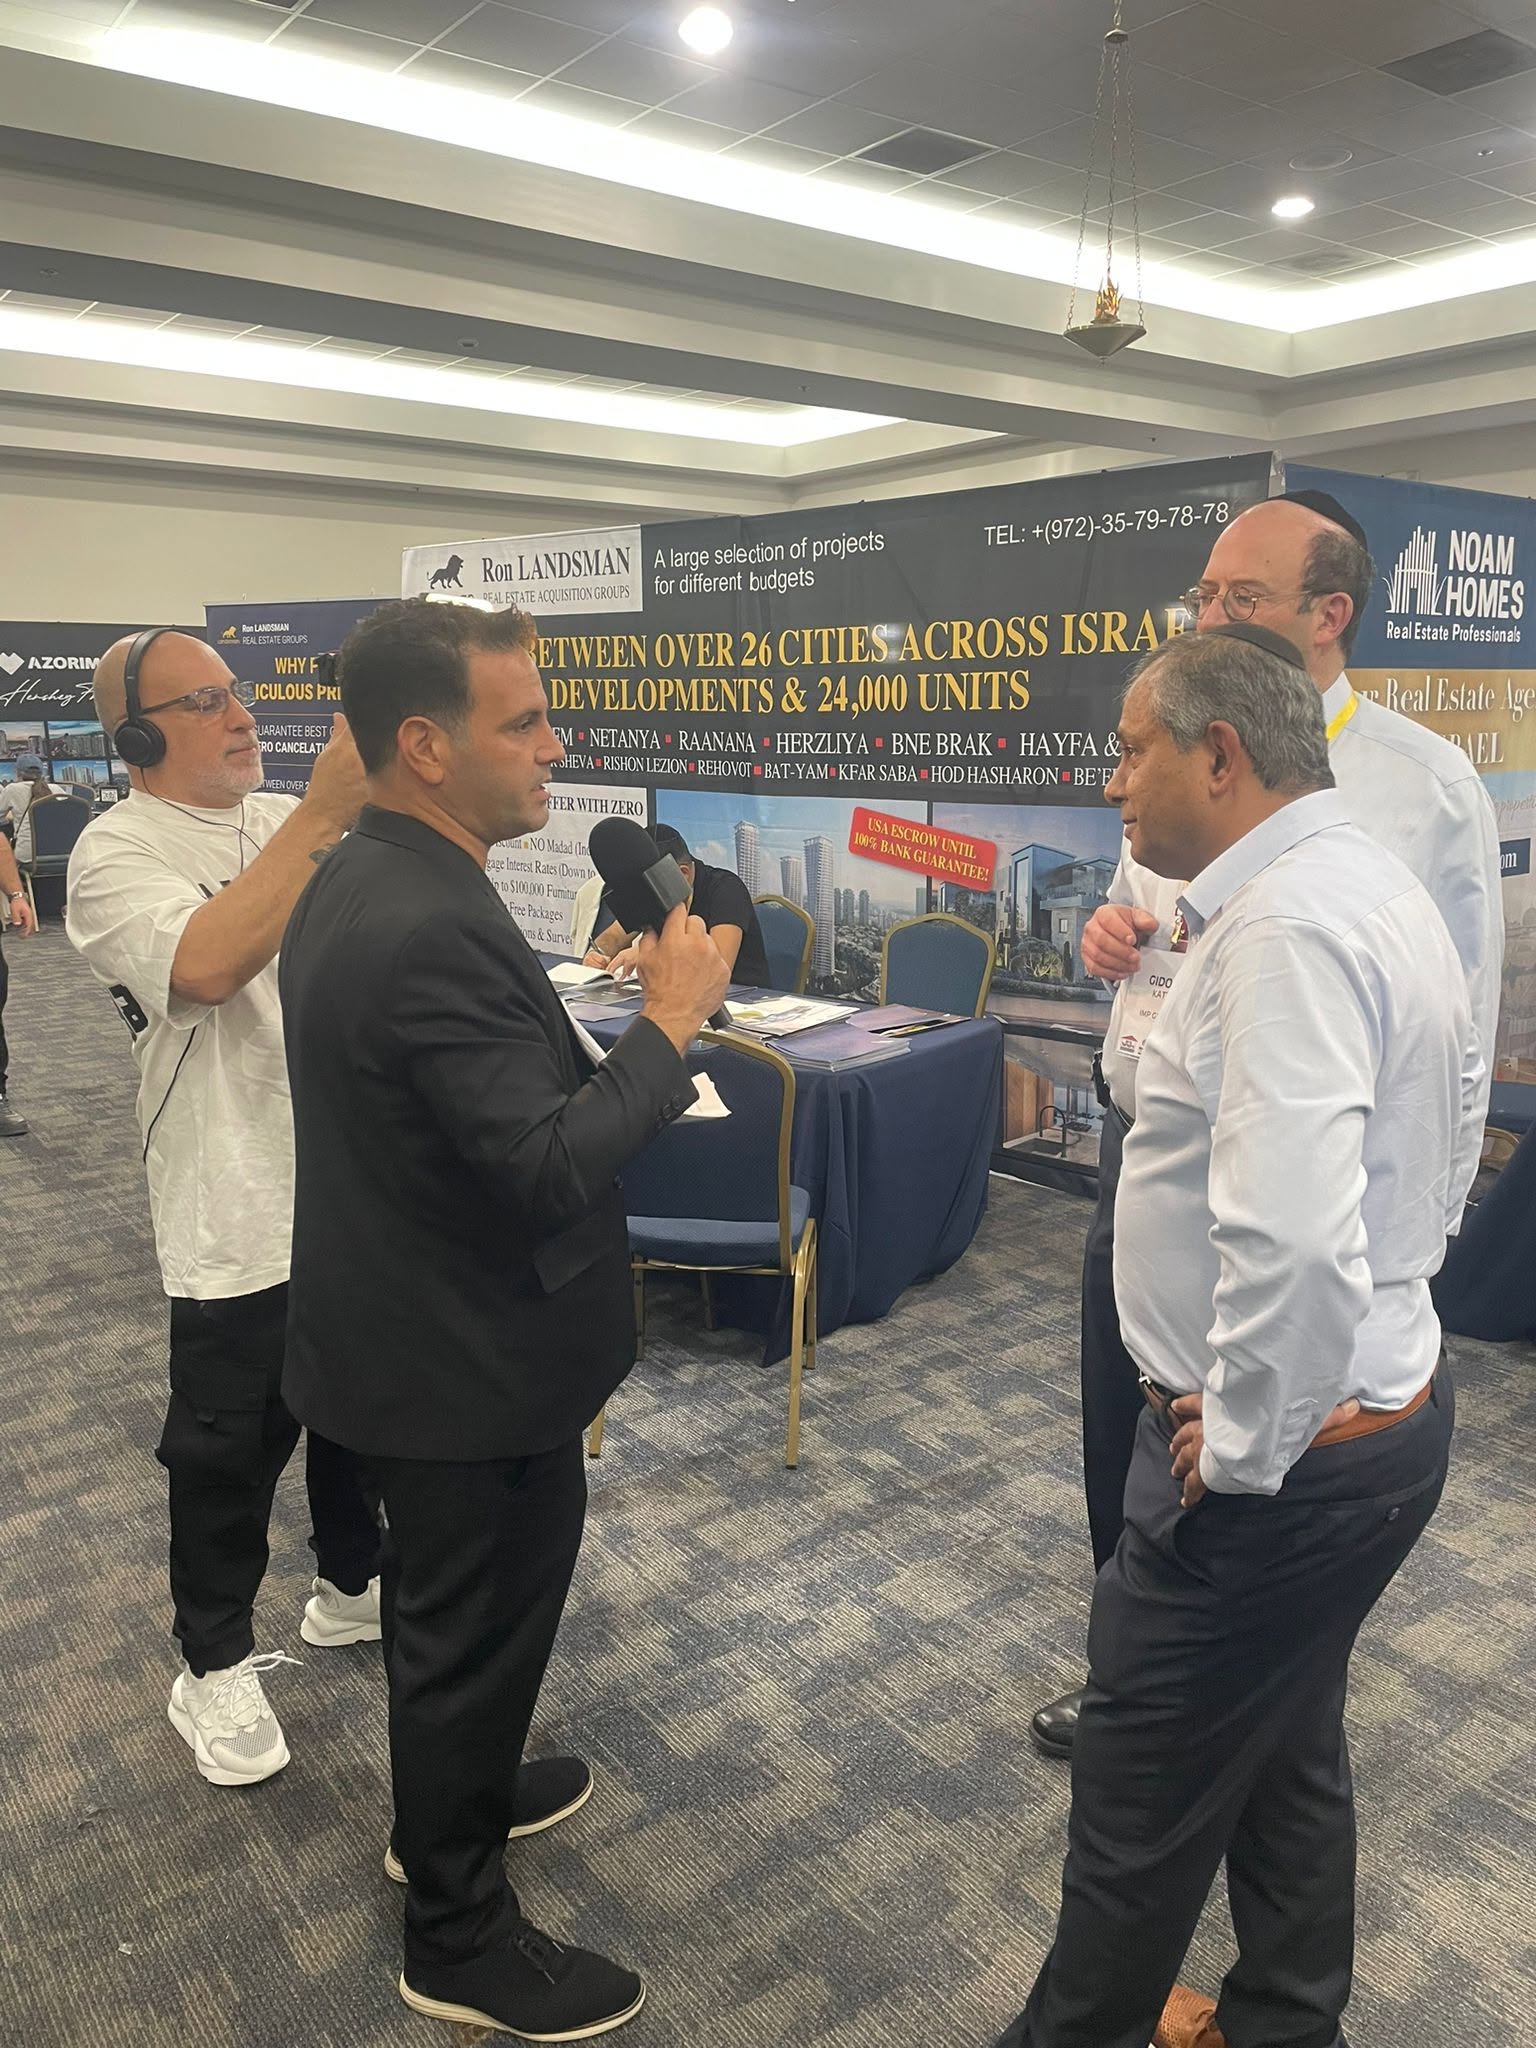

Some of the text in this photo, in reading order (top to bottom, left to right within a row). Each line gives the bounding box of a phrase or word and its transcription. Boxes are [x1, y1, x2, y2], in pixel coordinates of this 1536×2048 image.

[983, 501, 1229, 546] TEL: +(972)-35-79-78-78
[654, 530, 885, 571] A large selection of projects
[1448, 529, 1515, 576] NOAM
[482, 547, 631, 583] Ron LANDSMAN
[654, 567, 815, 595] for different budgets
[483, 584, 630, 605] REAL ESTATE ACQUISITION GROUPS
[1445, 575, 1525, 620] HOMES
[242, 623, 290, 633] Ron LANDSMAN
[242, 635, 258, 645] REAL
[258, 635, 281, 645] ESTATE
[281, 634, 308, 645] GROUPS
[1386, 620, 1521, 643] Real Estate Professionals
[653, 631, 736, 669] OVER
[740, 631, 773, 668] 26
[777, 623, 889, 667] CITIES
[898, 614, 1049, 663] ACROSS
[28, 656, 99, 670] AZORIM
[275, 657, 307, 675] WHY
[255, 683, 314, 701] ICULOUS
[550, 669, 1031, 720] DEVELOPMENTS & 24,000 UNITS
[1386, 674, 1431, 712] Real
[1435, 677, 1495, 712] Estate
[304, 725, 328, 738] BEST
[589, 727, 661, 750] NETANYA
[679, 730, 757, 753] RAANANA
[776, 732, 869, 755] HERZLIYA
[891, 732, 931, 755] BNE
[935, 732, 993, 756] BRAK
[1019, 731, 1098, 757] HAYFA
[1104, 731, 1122, 757] &
[275, 741, 328, 754] CANCELATI
[603, 755, 645, 772] RISHON
[646, 758, 688, 774] LEZION
[697, 759, 753, 778] REHOVOT
[764, 762, 829, 780] BAT-YAM
[838, 763, 876, 781] KFAR
[879, 764, 918, 782] SABA
[930, 765, 965, 784] HOD
[967, 766, 1060, 785] HASHARON
[286, 780, 304, 791] OVER
[577, 797, 611, 814] WITH
[611, 799, 644, 816] ZERO
[530, 838, 546, 852] NO
[547, 841, 573, 855] Madad
[868, 817, 977, 859] USA ESCROW UNTIL
[854, 831, 989, 881] 100% BANK GUARANTEE!
[506, 857, 533, 873] Interest
[535, 860, 558, 875] Rates
[558, 863, 587, 879] (Down
[587, 867, 596, 881] to
[501, 880, 509, 892] to
[510, 879, 545, 897] $100,000
[509, 901, 564, 923] Free Packages
[537, 927, 545, 942] &
